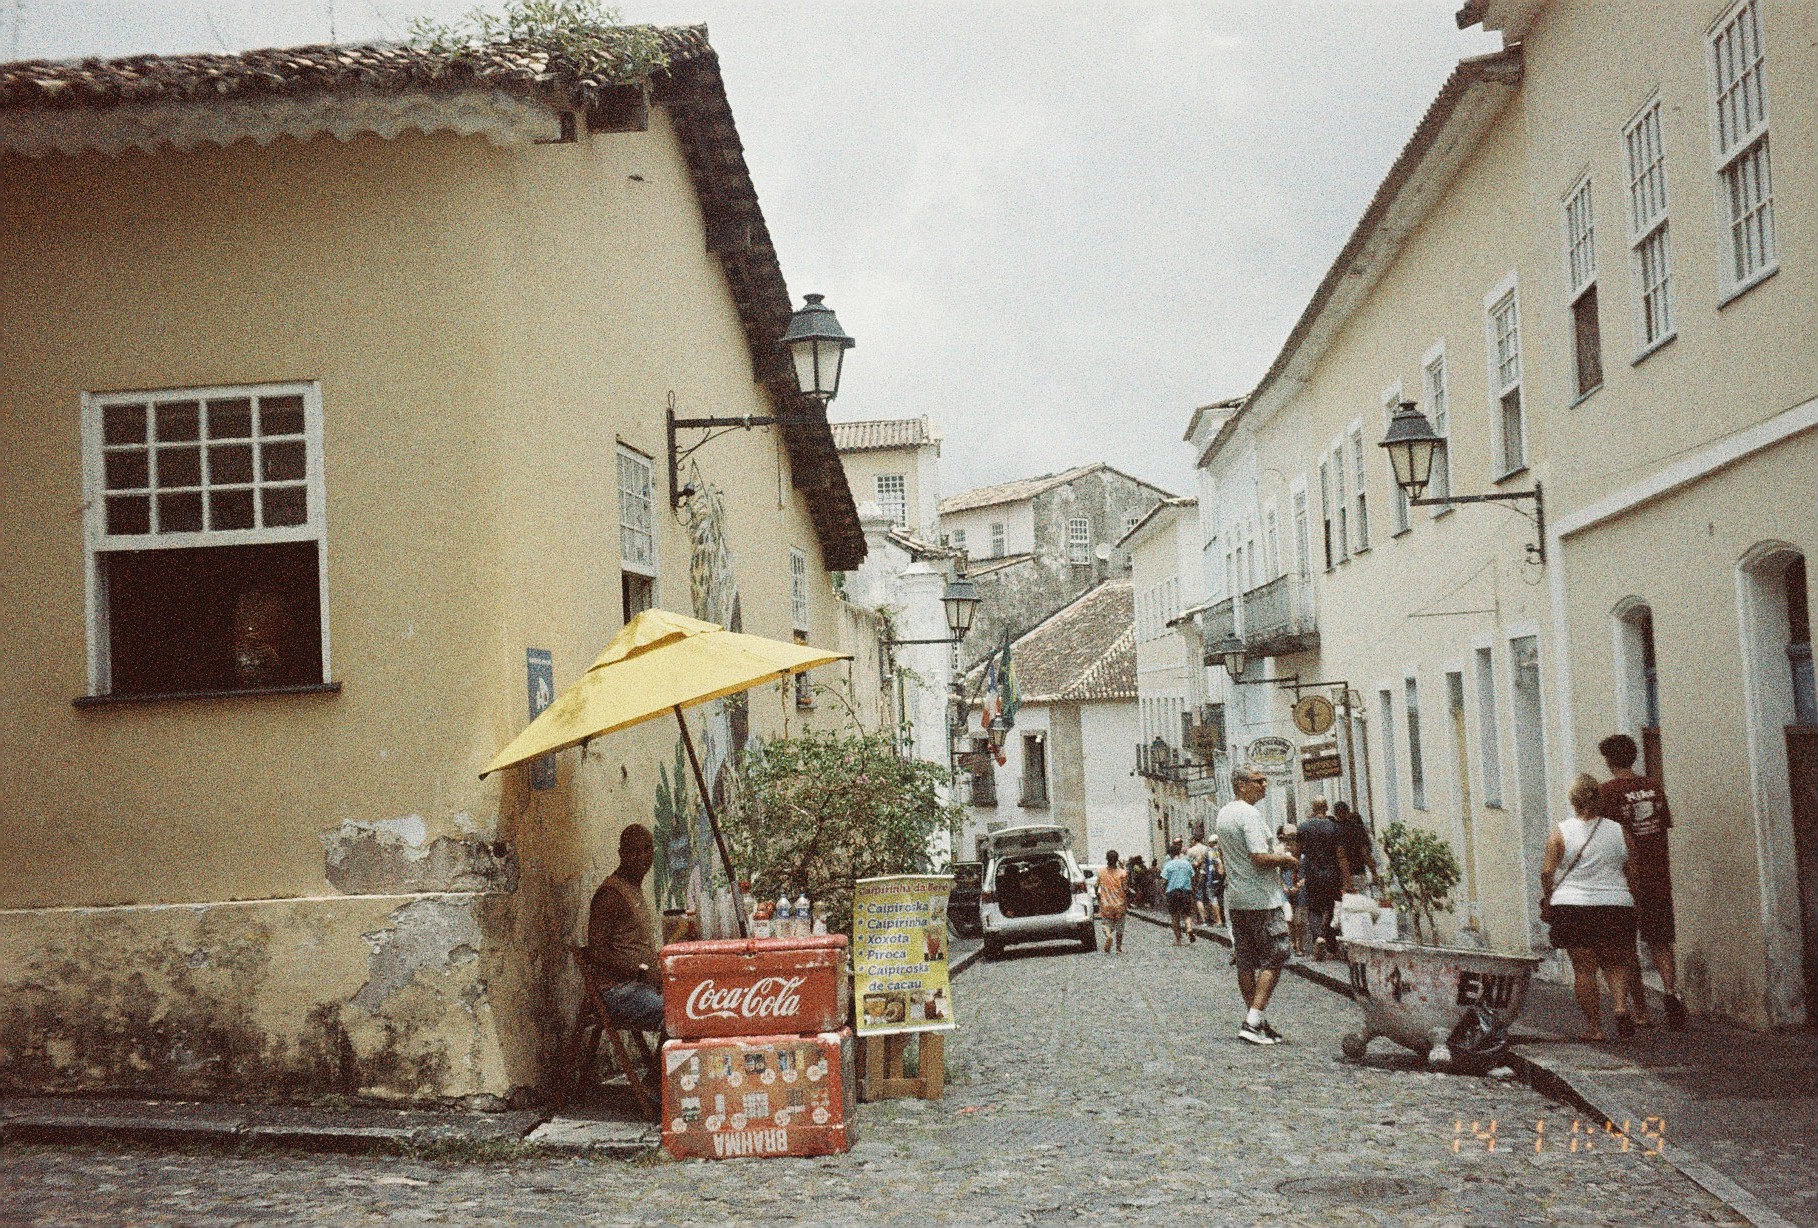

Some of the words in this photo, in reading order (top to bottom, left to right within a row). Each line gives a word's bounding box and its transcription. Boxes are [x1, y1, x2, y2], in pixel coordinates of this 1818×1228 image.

[914, 882, 926, 892] da
[867, 917, 928, 930] Caipirinha
[867, 934, 909, 945] Xoxota
[867, 949, 906, 960] Piroca
[869, 981, 884, 991] de
[887, 980, 922, 991] cacau
[713, 1128, 788, 1156] BRAHMA
